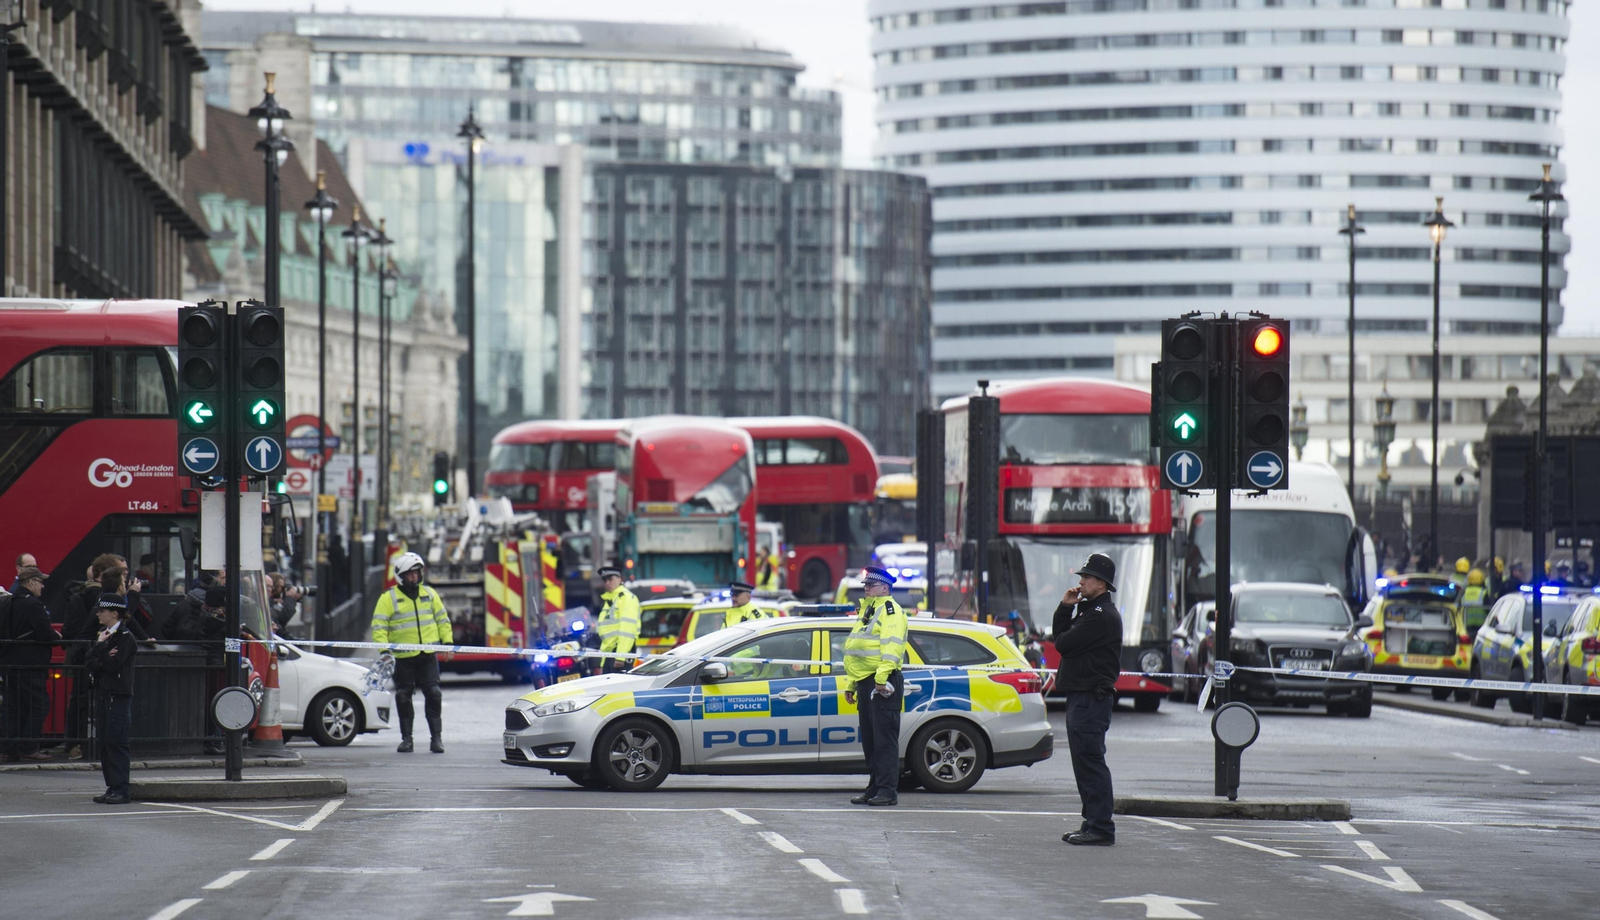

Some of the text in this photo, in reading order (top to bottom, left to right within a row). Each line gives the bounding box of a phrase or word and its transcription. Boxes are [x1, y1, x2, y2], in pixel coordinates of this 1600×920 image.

[87, 457, 174, 488] Go Ahead-London
[128, 501, 159, 510] LT484
[1062, 498, 1092, 512] Arch
[1107, 495, 1138, 516] 159
[703, 726, 862, 749] POLIC
